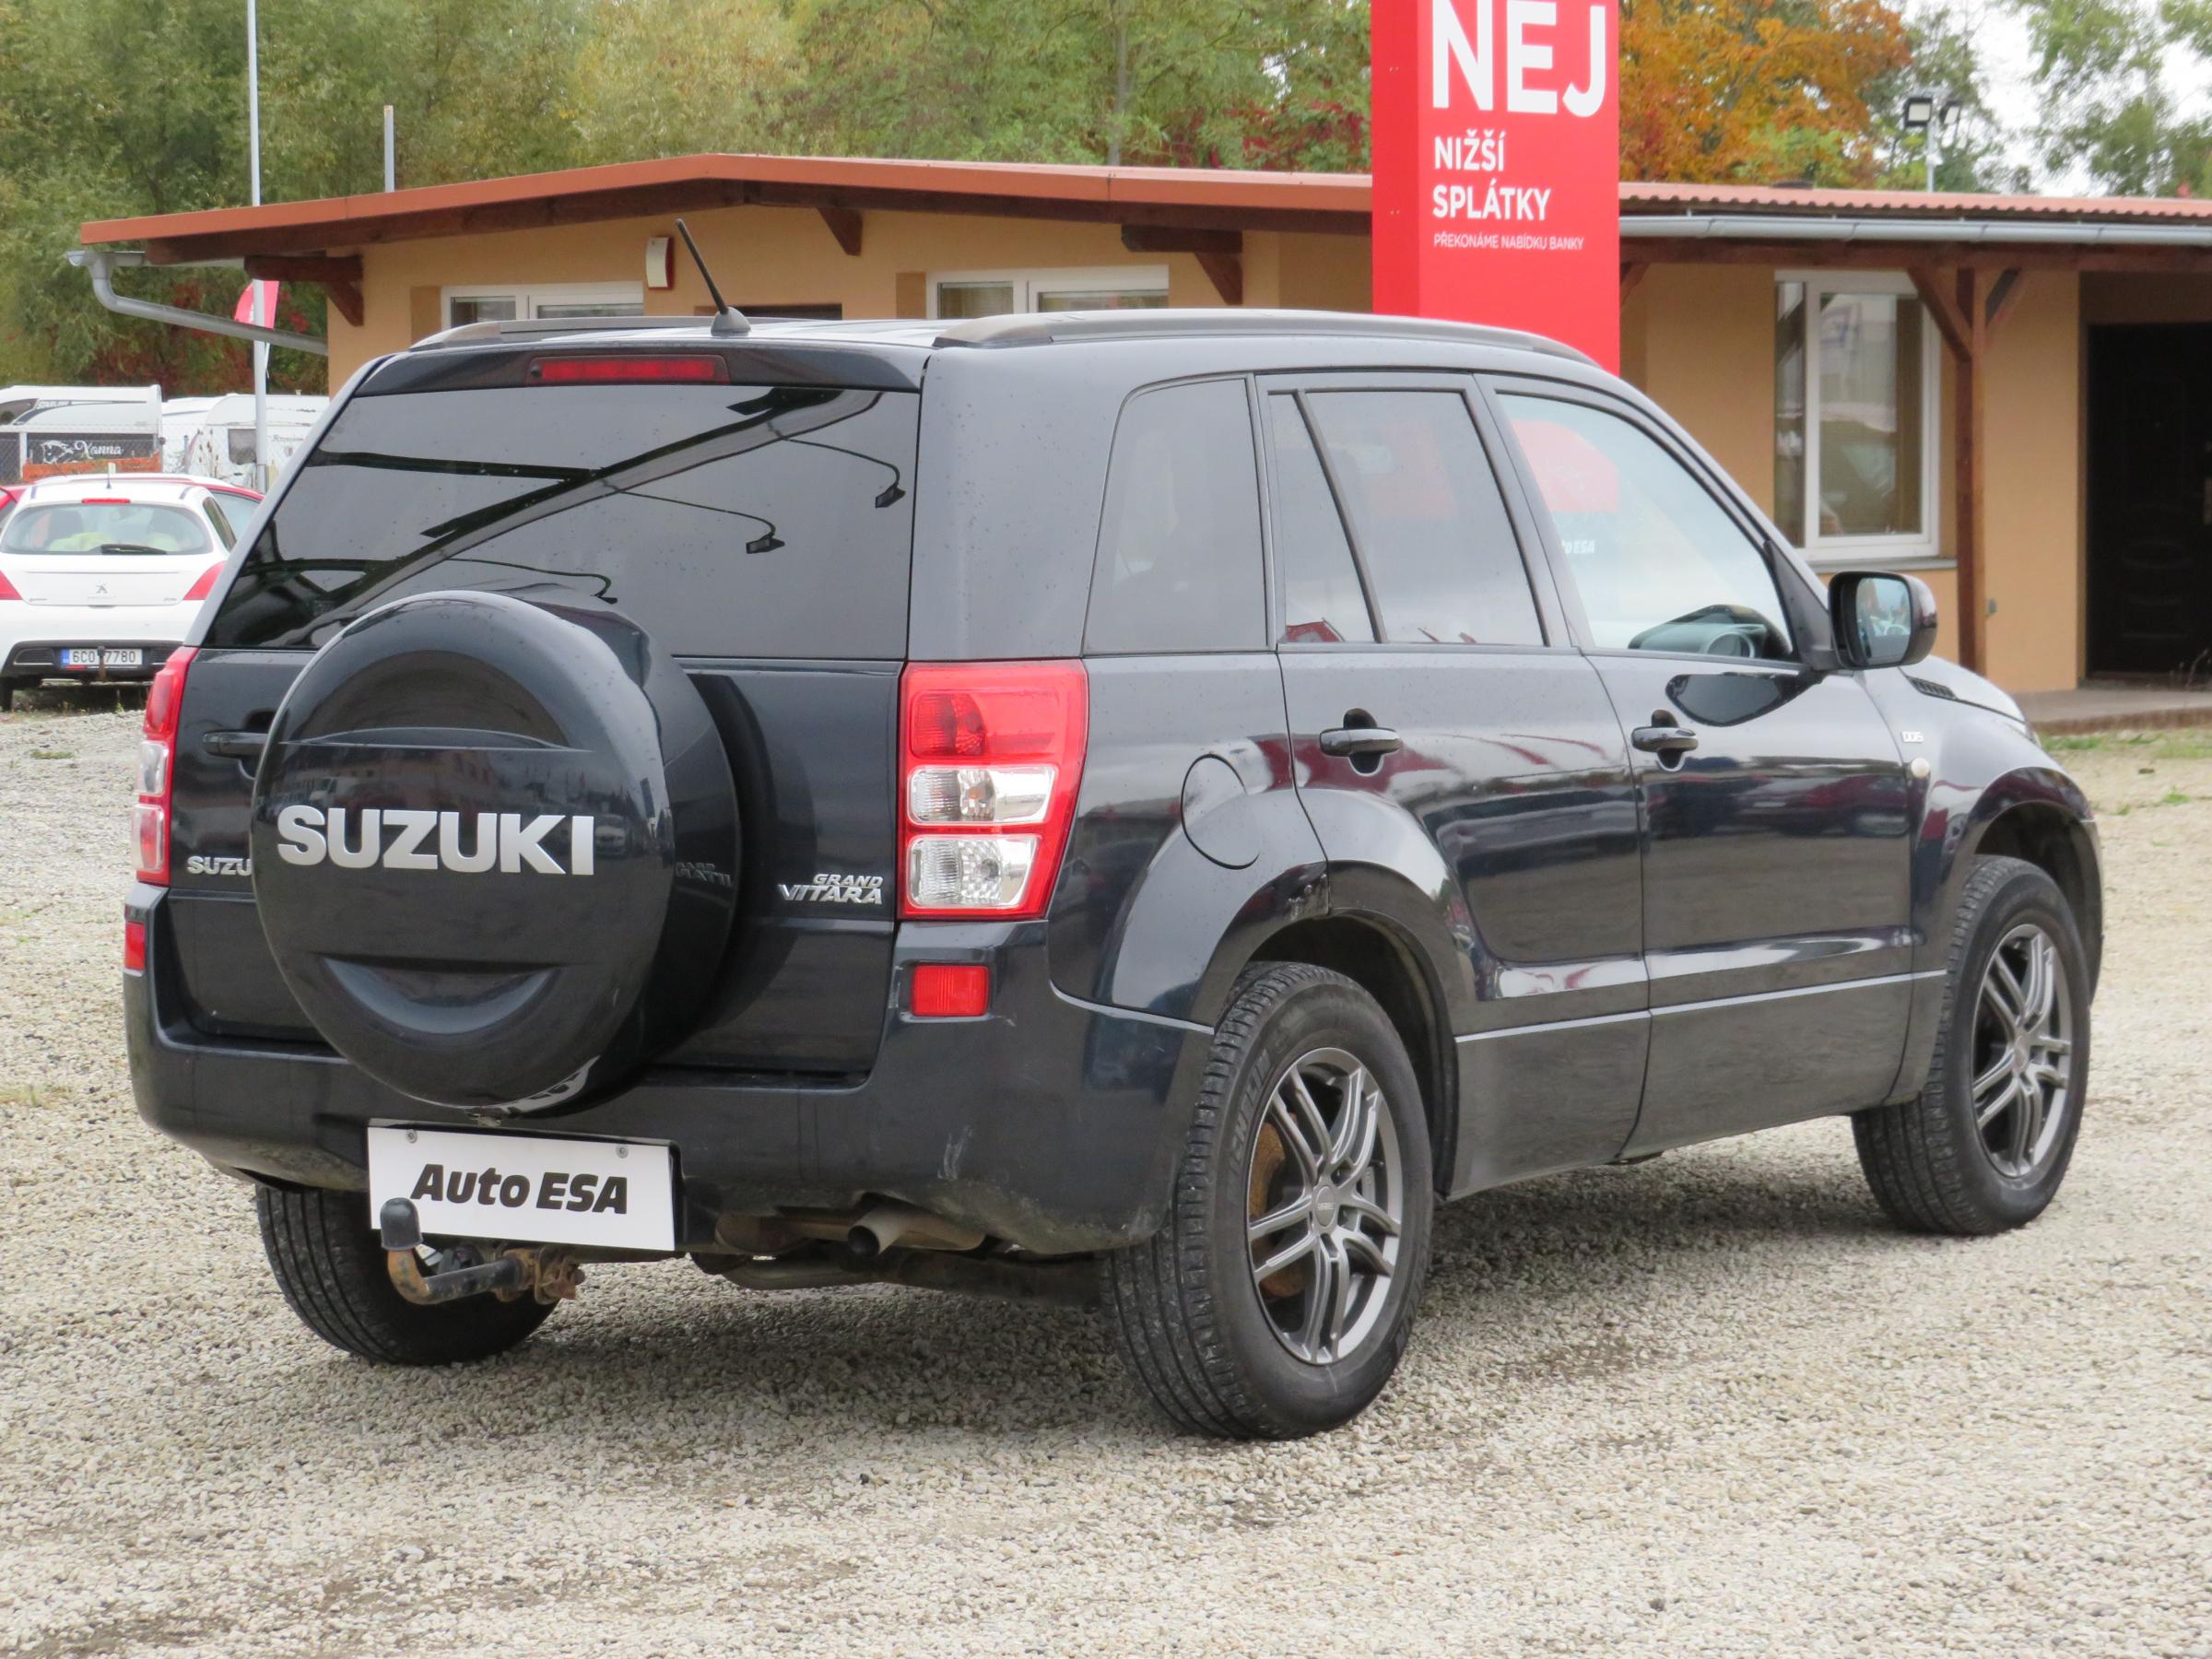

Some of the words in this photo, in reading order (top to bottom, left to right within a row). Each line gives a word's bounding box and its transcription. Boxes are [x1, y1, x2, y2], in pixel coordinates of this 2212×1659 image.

[1432, 0, 1606, 117] NEJ
[1434, 129, 1505, 171] NIŽŠÍ
[1432, 178, 1550, 220] SPLÁTKY
[1433, 230, 1499, 249] PŘEKONÁME
[1501, 231, 1547, 250] NABÍDKU
[1549, 236, 1584, 250] BANKY
[277, 805, 594, 876] SUZUKI
[187, 855, 252, 876] SUZU
[813, 873, 883, 888] GRAND
[778, 884, 882, 904] VITARA
[410, 1163, 530, 1207] Auto
[535, 1171, 628, 1215] ESA
